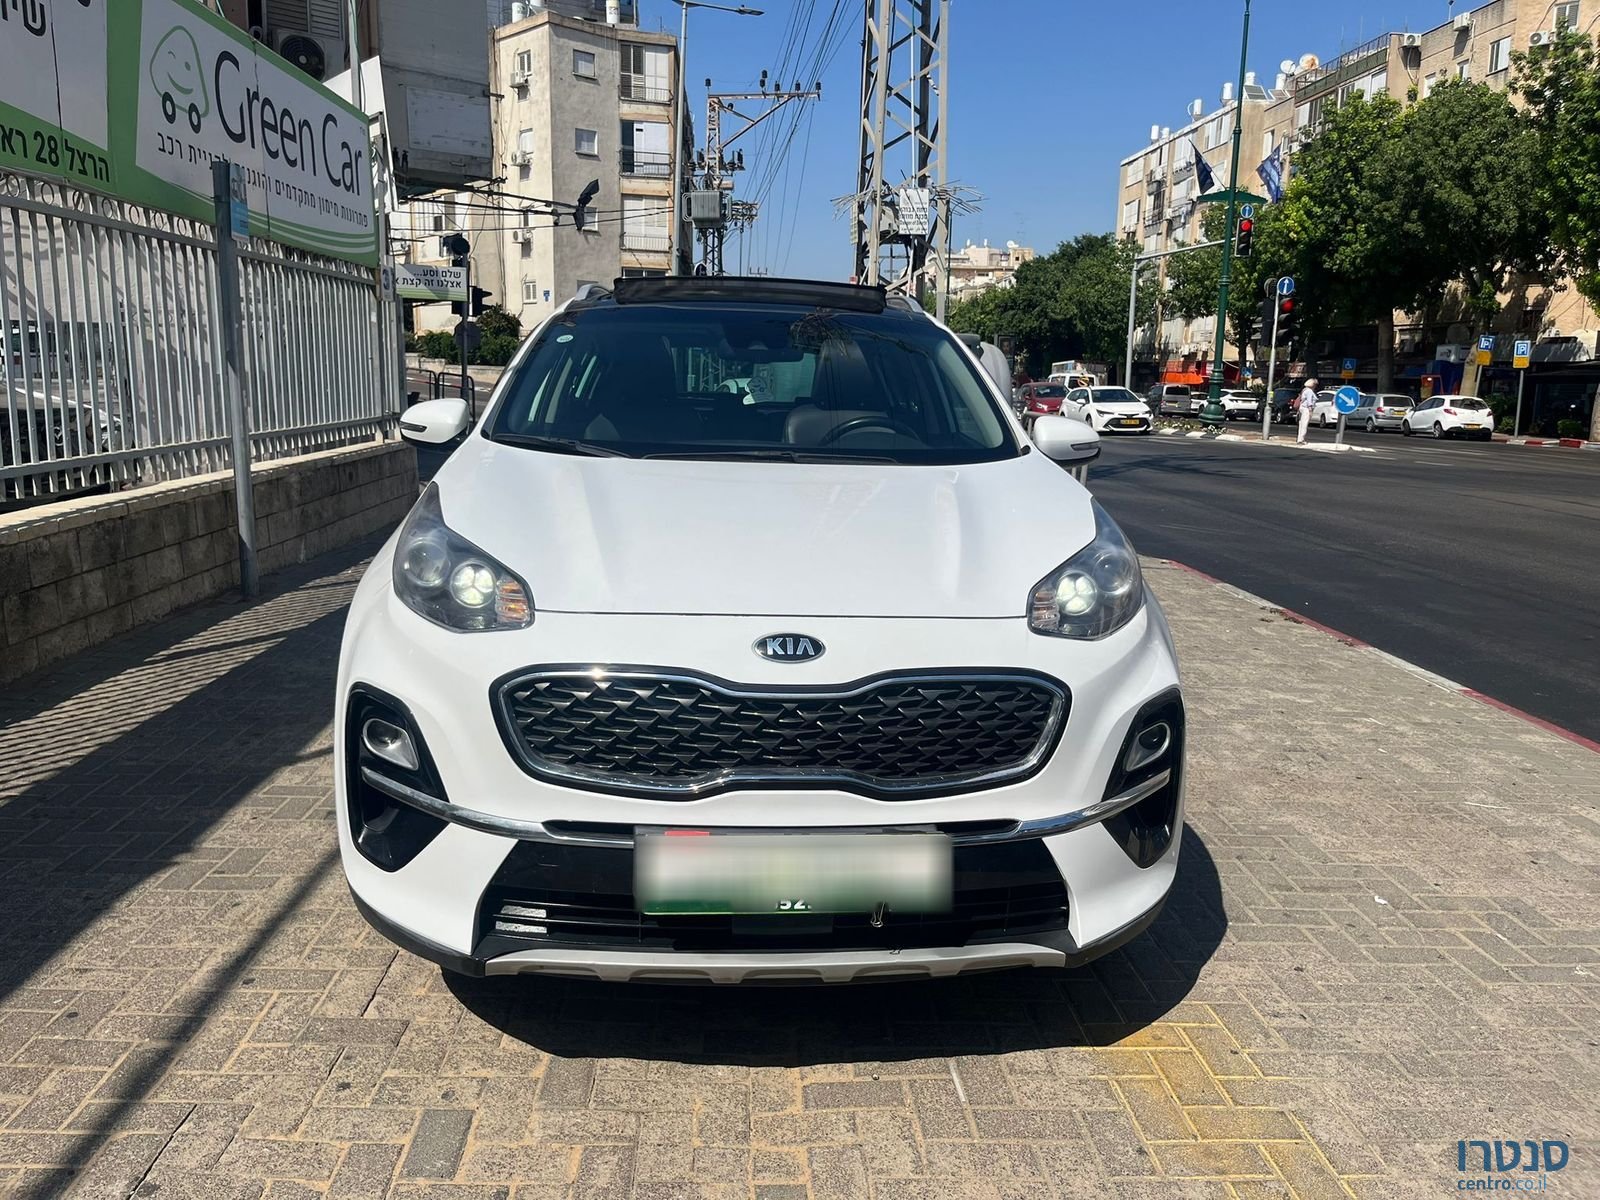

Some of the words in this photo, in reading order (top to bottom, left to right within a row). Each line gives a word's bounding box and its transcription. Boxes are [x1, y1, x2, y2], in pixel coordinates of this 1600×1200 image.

[214, 50, 317, 177] Green
[321, 113, 362, 196] Car
[33, 130, 60, 167] 28
[157, 132, 183, 159] רכב
[64, 138, 110, 183] הרצל
[275, 179, 316, 208] מתקדמים
[318, 196, 339, 217] מימון
[341, 205, 368, 228] פתרונות
[402, 278, 421, 288] קצת
[424, 278, 434, 287] זה
[437, 279, 462, 288] אצלנו
[441, 269, 461, 278] שלם
[766, 637, 815, 656] KIA
